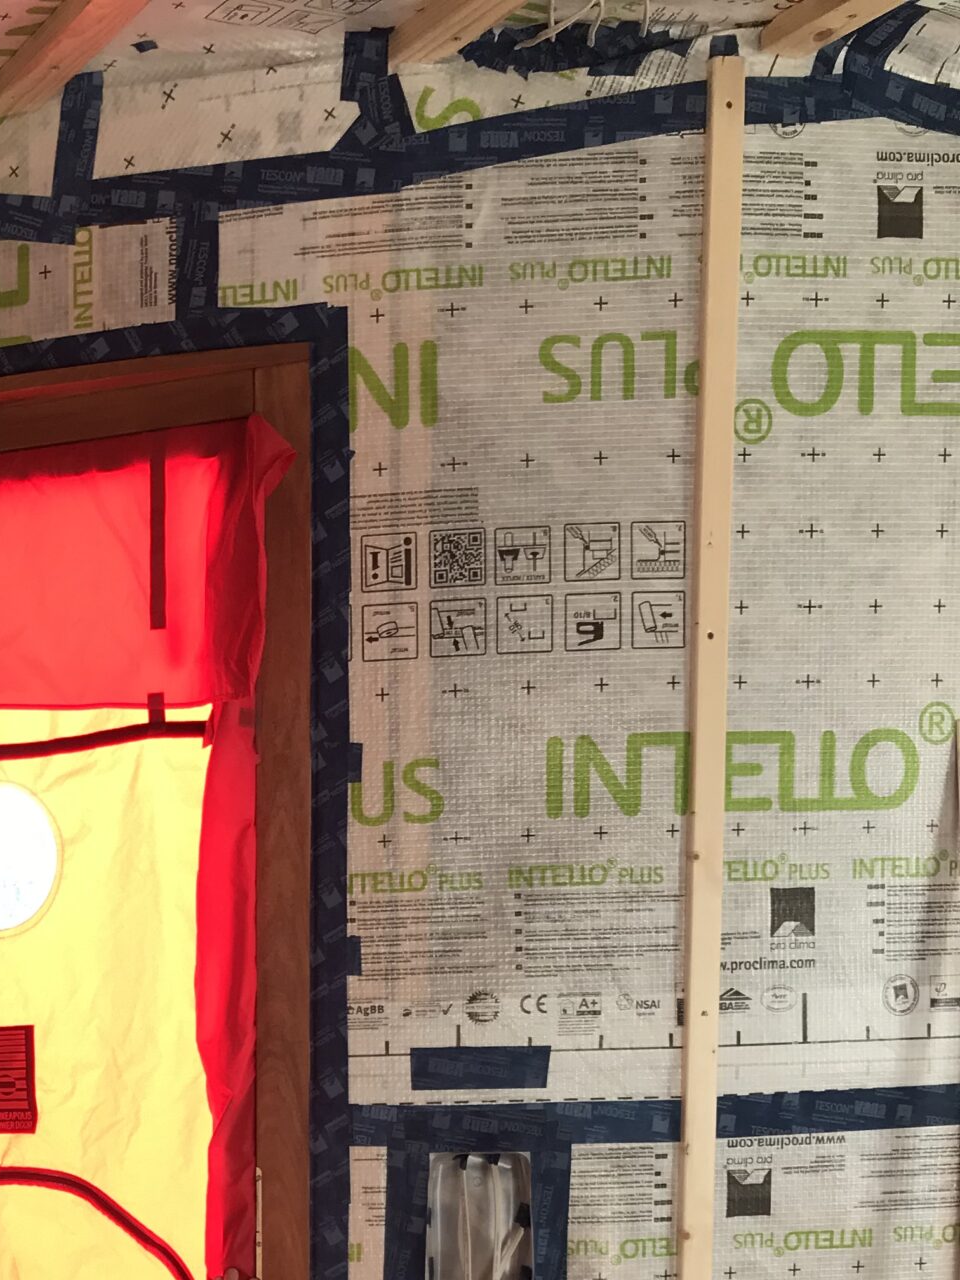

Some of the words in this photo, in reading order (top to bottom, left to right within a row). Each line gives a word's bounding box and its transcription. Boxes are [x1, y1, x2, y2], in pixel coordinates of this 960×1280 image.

[509, 261, 557, 282] PLUS
[870, 256, 914, 276] PLUS
[322, 272, 370, 295] PLUS
[620, 864, 664, 885] PLUS
[788, 862, 831, 881] PLUS
[733, 1232, 774, 1251] PLUS
